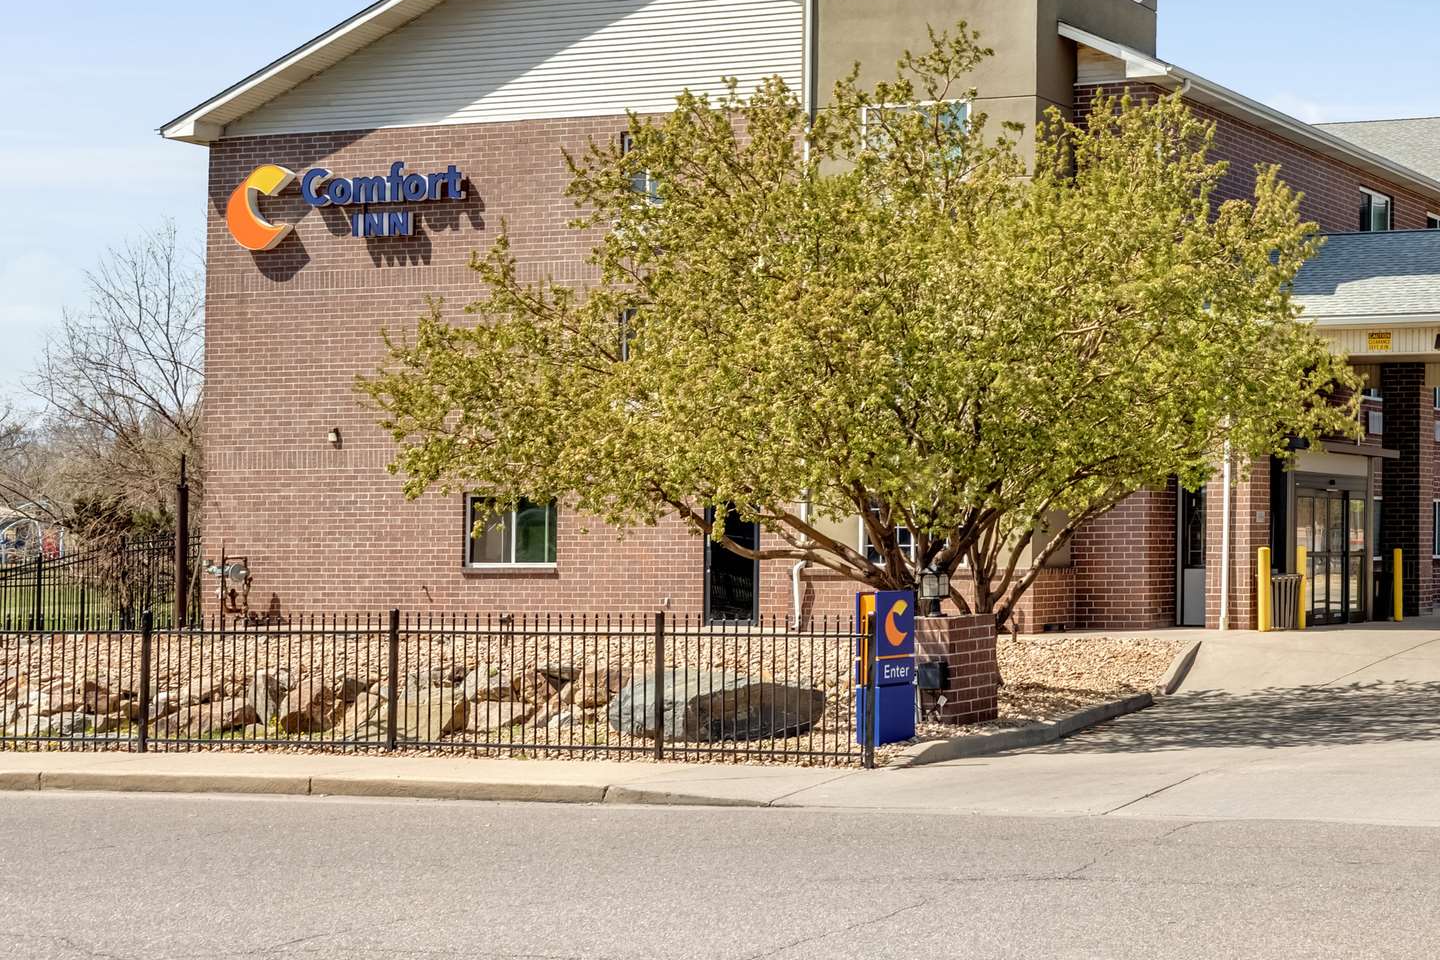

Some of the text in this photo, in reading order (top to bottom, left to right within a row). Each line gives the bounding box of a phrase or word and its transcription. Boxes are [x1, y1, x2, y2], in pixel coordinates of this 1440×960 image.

[302, 161, 463, 208] Comfort
[351, 210, 410, 238] INN
[884, 664, 910, 680] Enter
